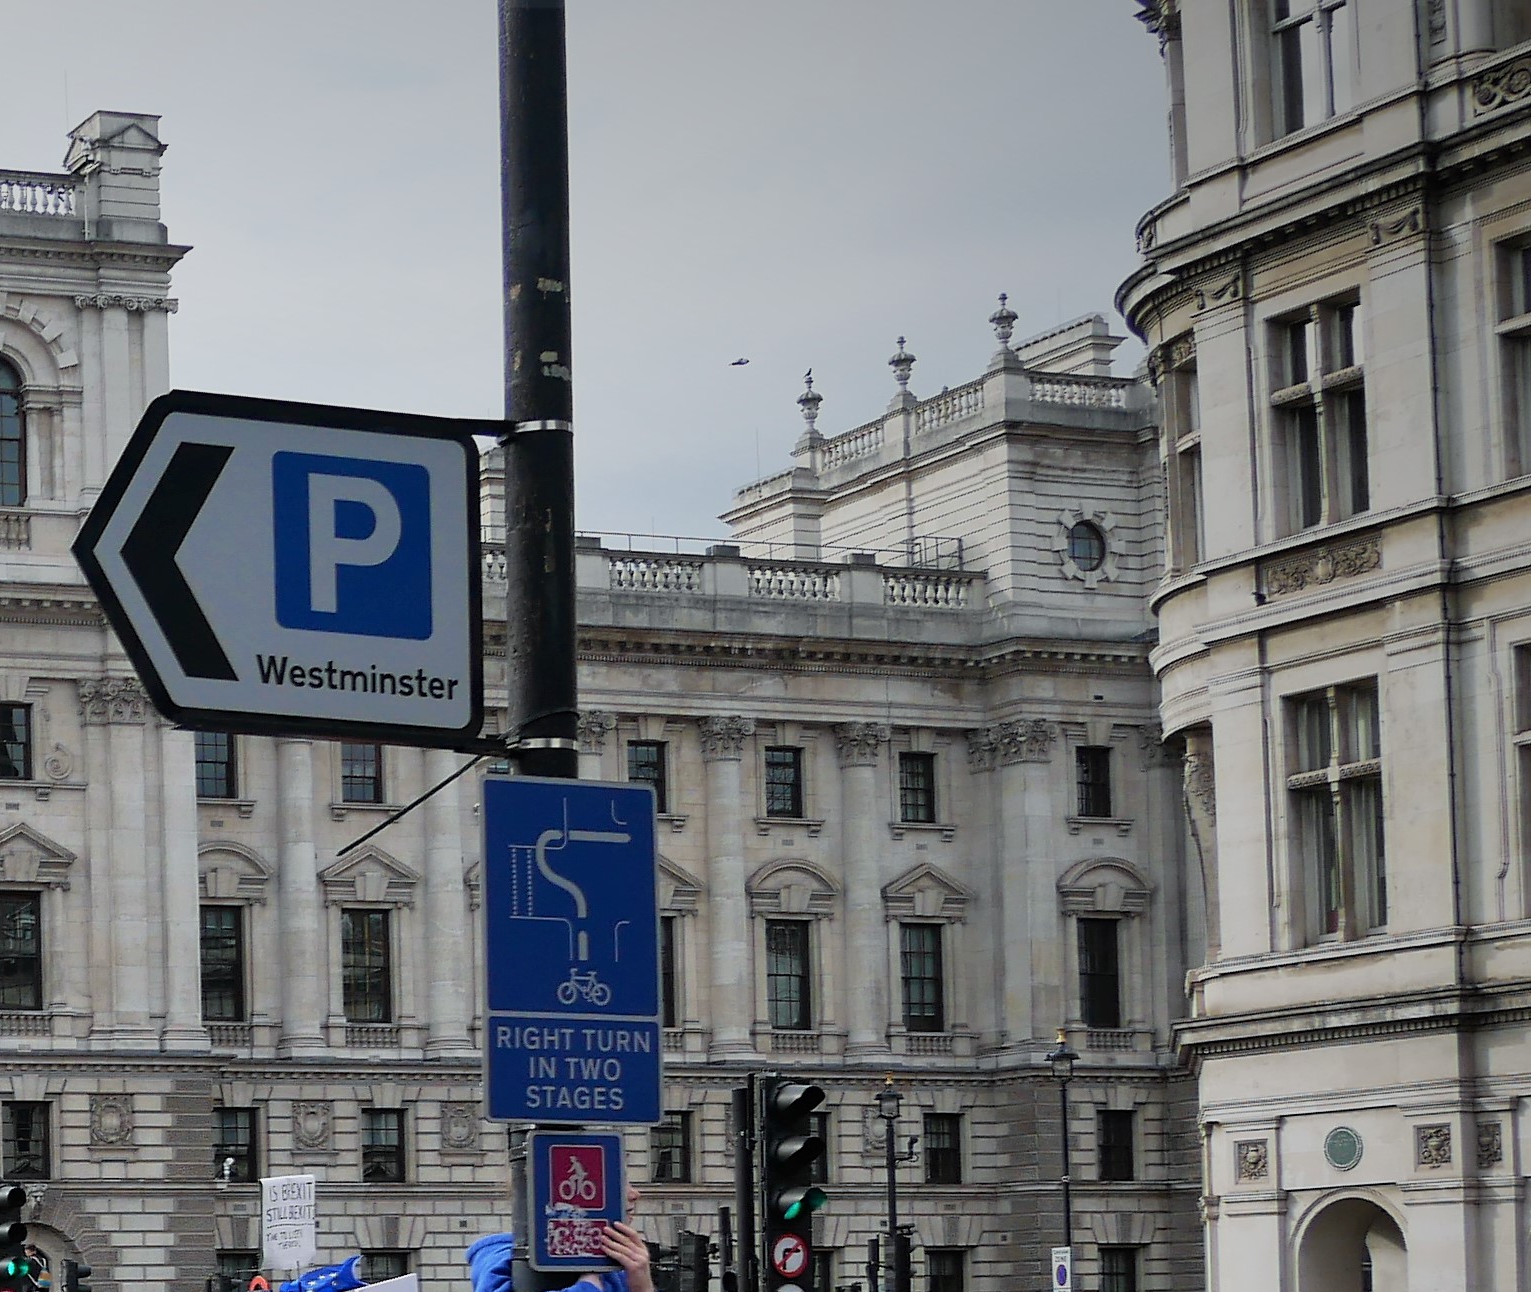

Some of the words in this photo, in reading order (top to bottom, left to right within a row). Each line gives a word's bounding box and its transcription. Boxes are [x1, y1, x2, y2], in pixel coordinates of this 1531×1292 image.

[307, 471, 402, 614] P
[255, 653, 460, 701] Westminster
[496, 1025, 575, 1050] RIGHT
[582, 1029, 651, 1053] TURN
[528, 1056, 557, 1079] IN
[564, 1058, 622, 1082] TWO
[525, 1085, 624, 1111] STAGES
